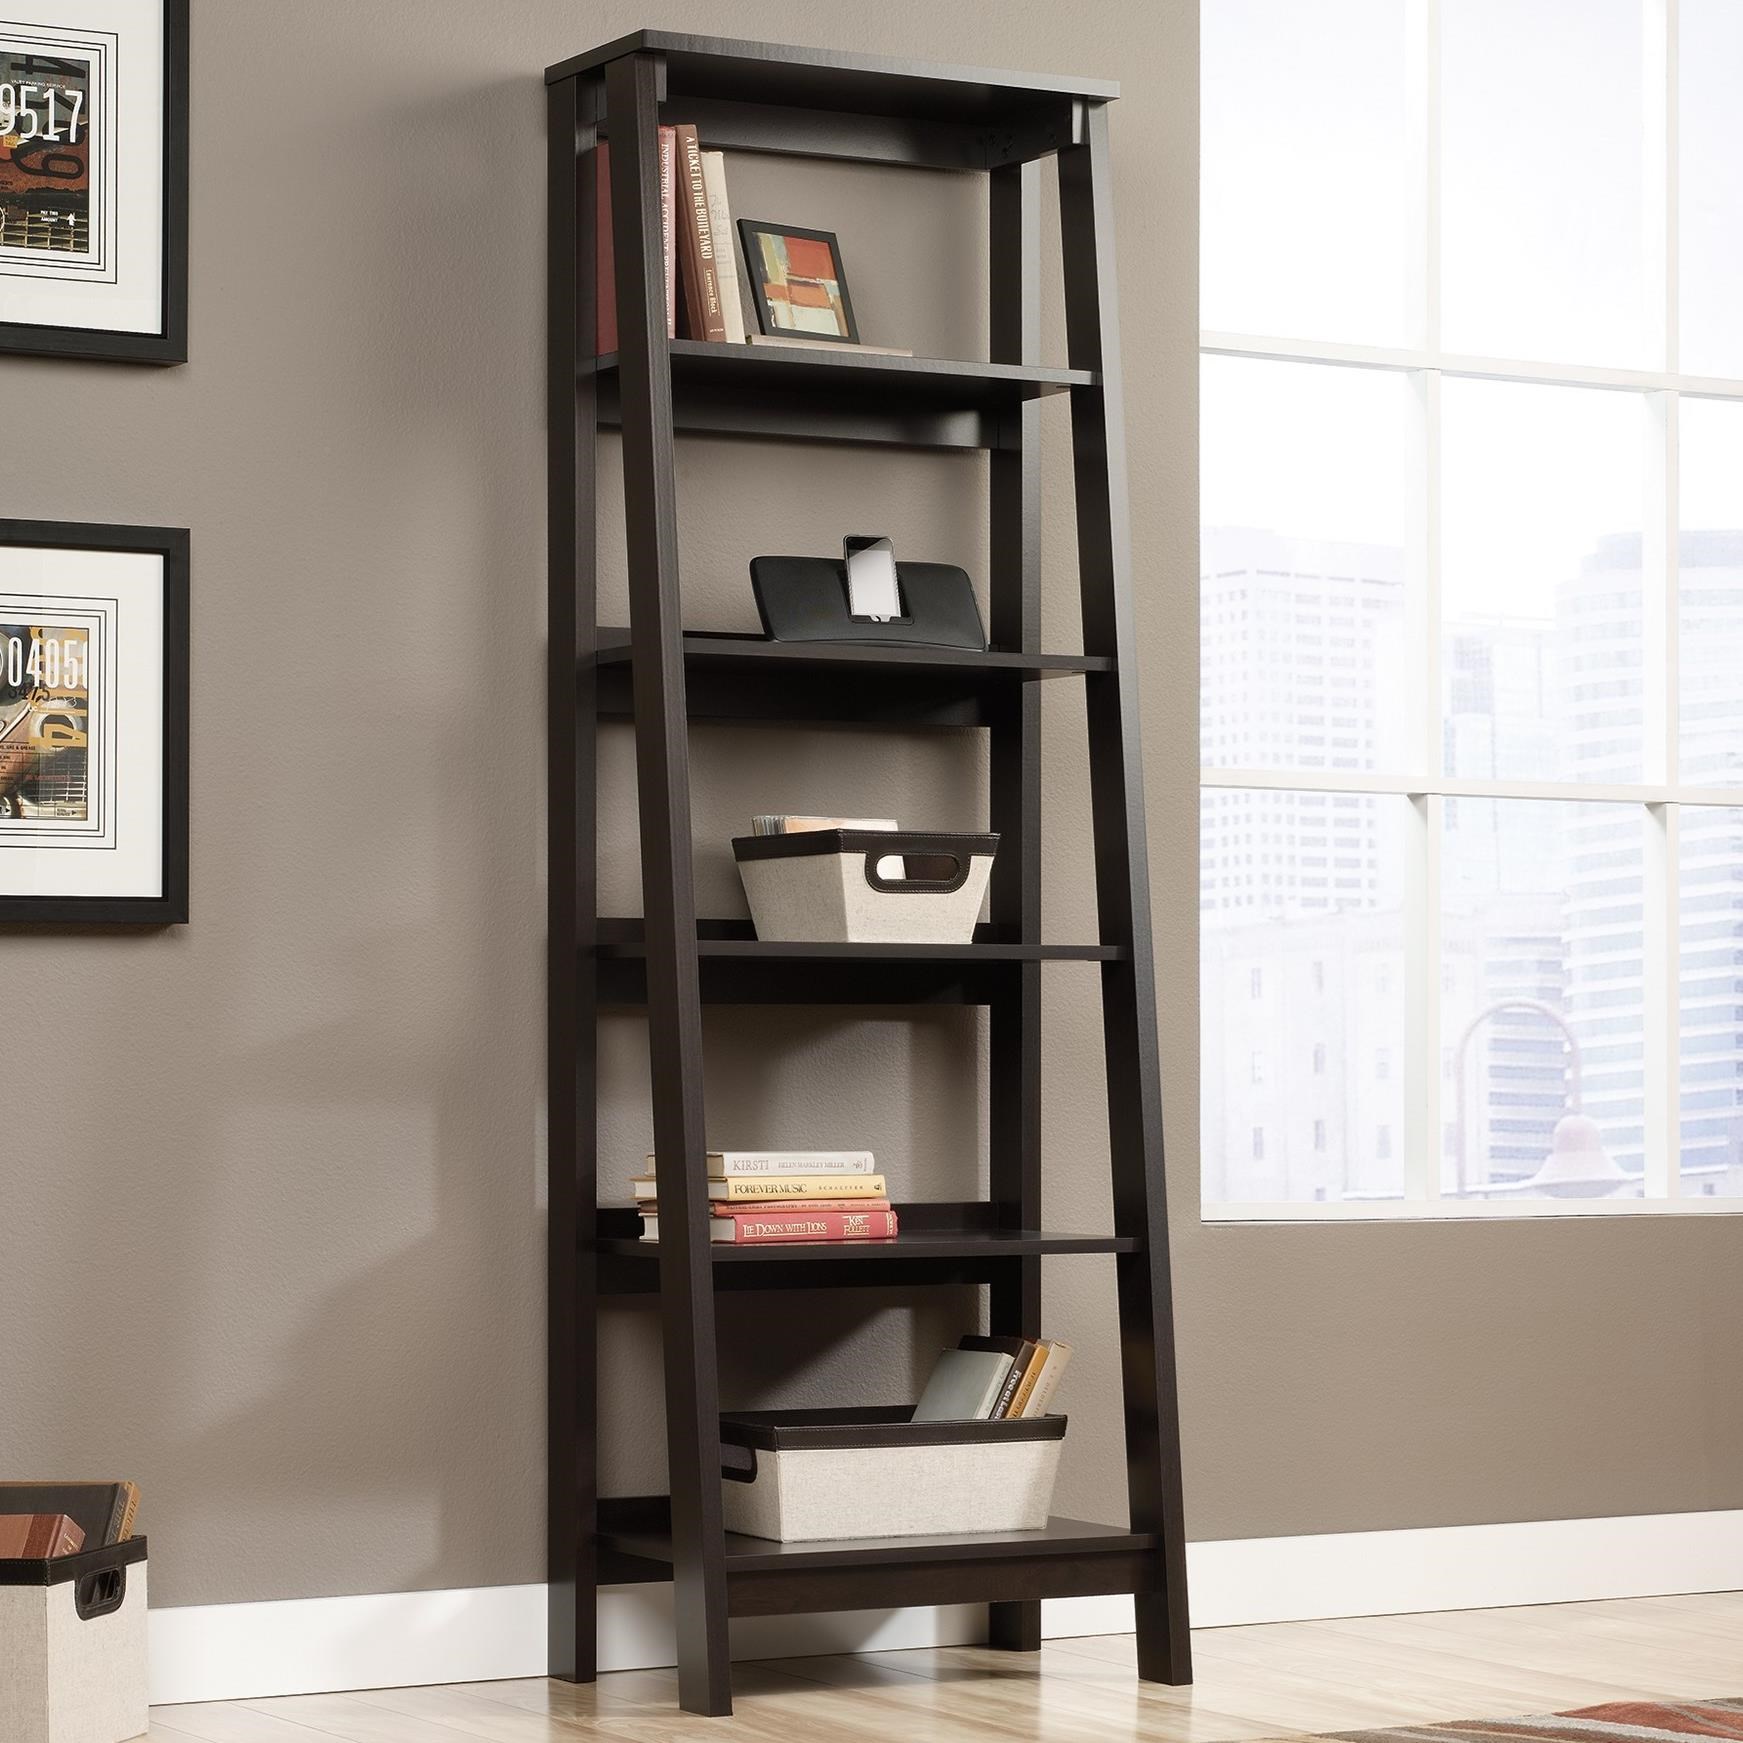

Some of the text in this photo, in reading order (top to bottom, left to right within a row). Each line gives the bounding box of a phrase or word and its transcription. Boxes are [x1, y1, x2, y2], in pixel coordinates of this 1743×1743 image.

[0, 83, 83, 143] 9517
[687, 144, 701, 178] TICKET
[660, 143, 669, 199] INDUSTRIAL
[691, 179, 702, 190] TO
[693, 190, 705, 208] THE
[695, 208, 713, 260] BONEYARD
[705, 269, 718, 314] Lawrence Block
[733, 1159, 769, 1171] KIRSTI
[734, 1184, 778, 1194] FOREVER
[779, 1184, 807, 1193] MUSIC
[743, 1221, 828, 1237] LIE DOWN WITH LIONS
[848, 1216, 864, 1225] KEN
[843, 1224, 871, 1235] FOLLETT
[1007, 1370, 1022, 1391] Free
[1003, 1390, 1011, 1401] at
